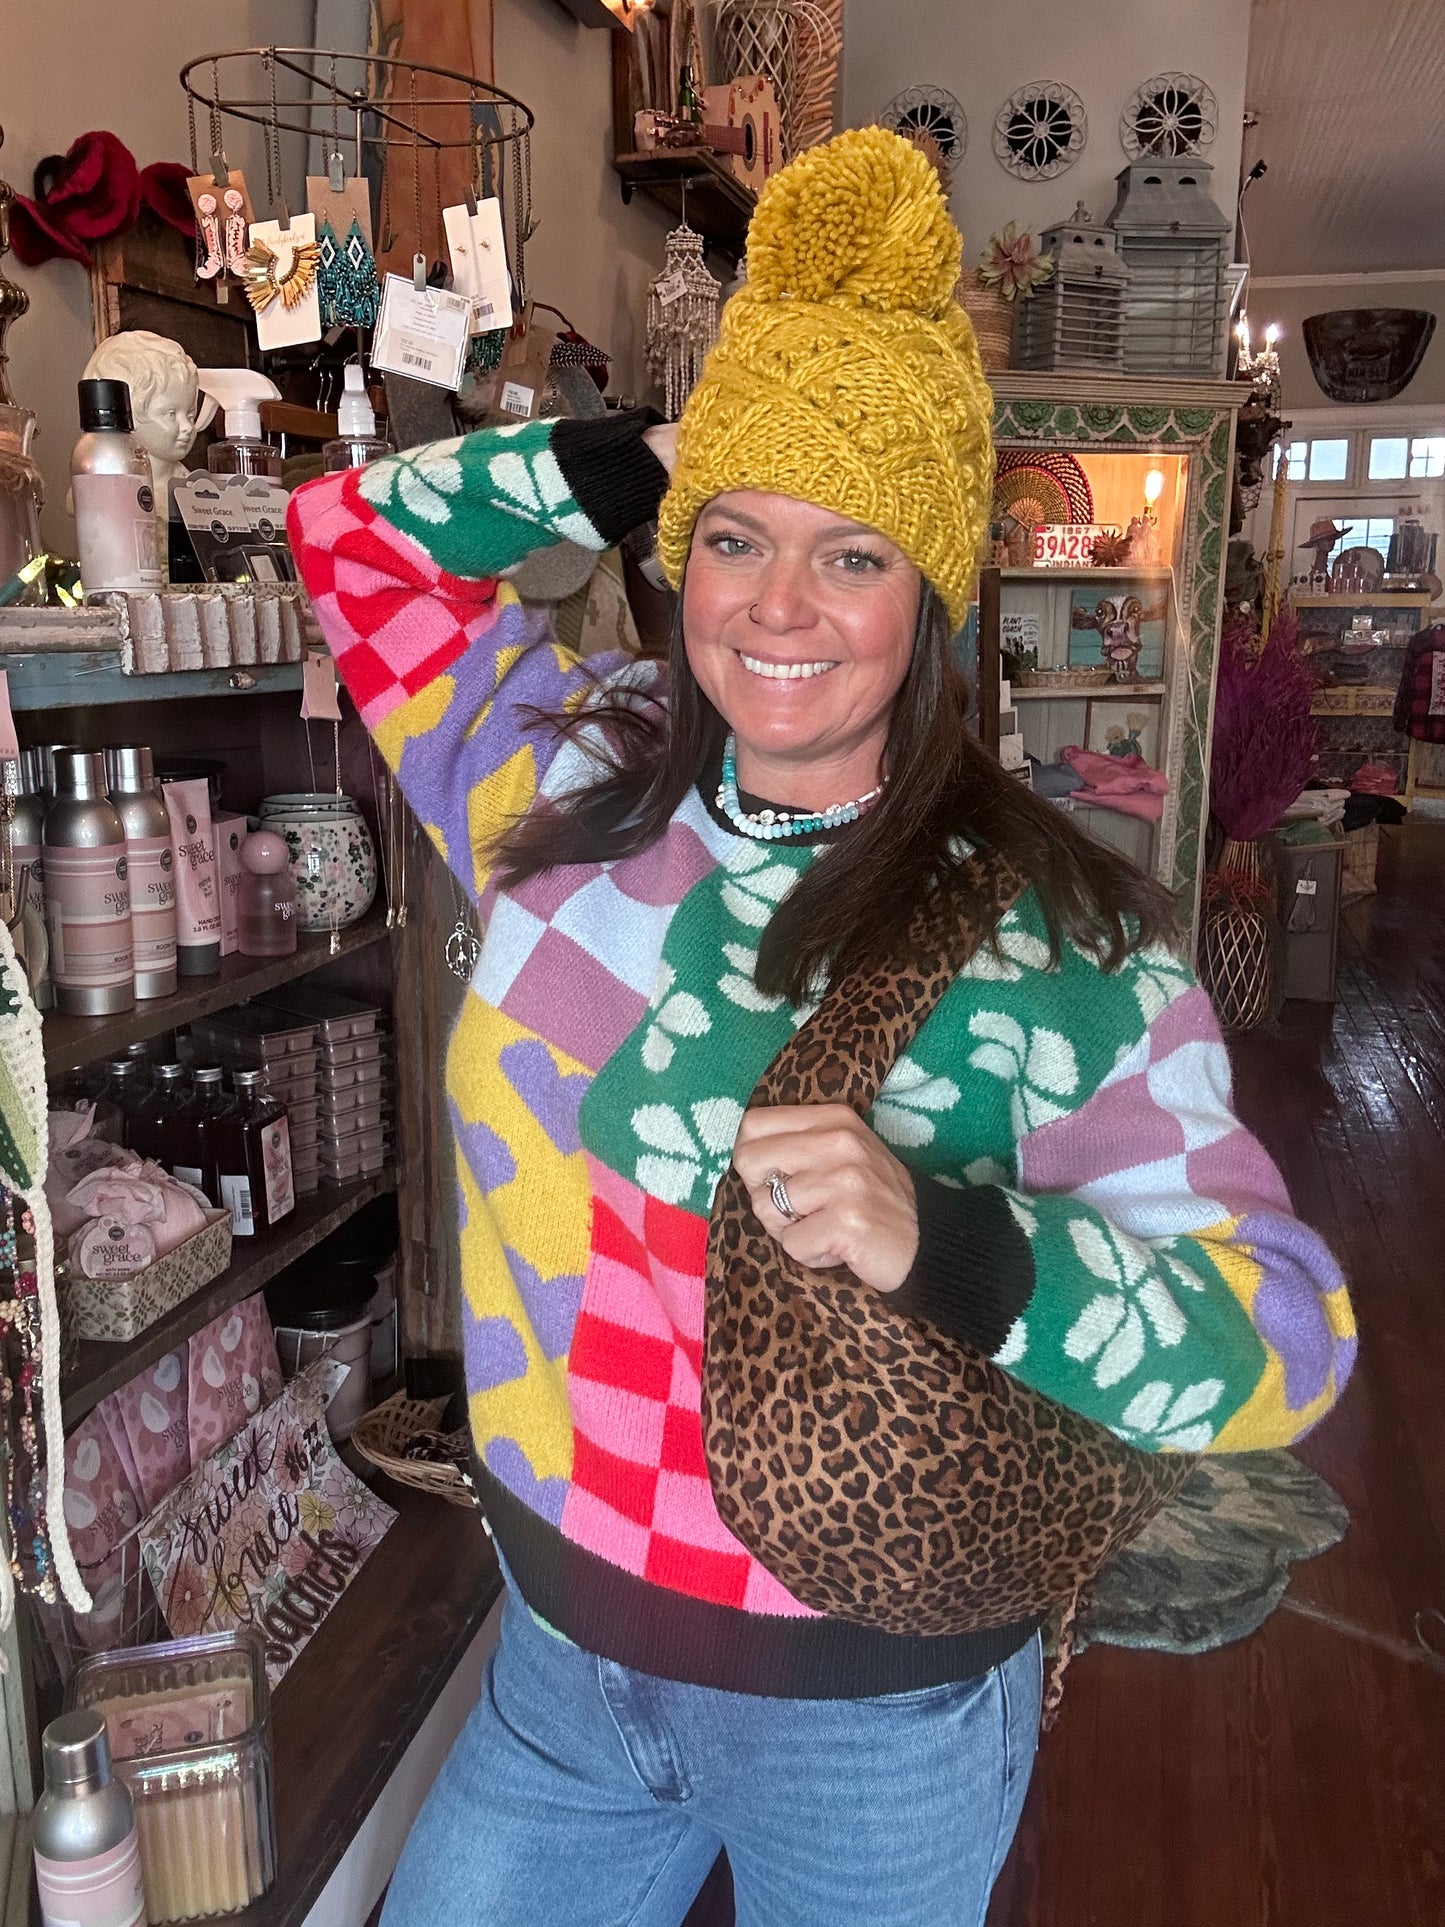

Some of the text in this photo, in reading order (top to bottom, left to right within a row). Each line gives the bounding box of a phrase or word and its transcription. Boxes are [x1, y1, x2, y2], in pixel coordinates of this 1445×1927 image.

[192, 505, 233, 516] Sweet Grace
[262, 505, 282, 514] Grace
[1053, 560, 1095, 568] INDIAN
[179, 839, 206, 857] sweet
[190, 851, 215, 871] grace
[92, 1244, 130, 1254] sweet
